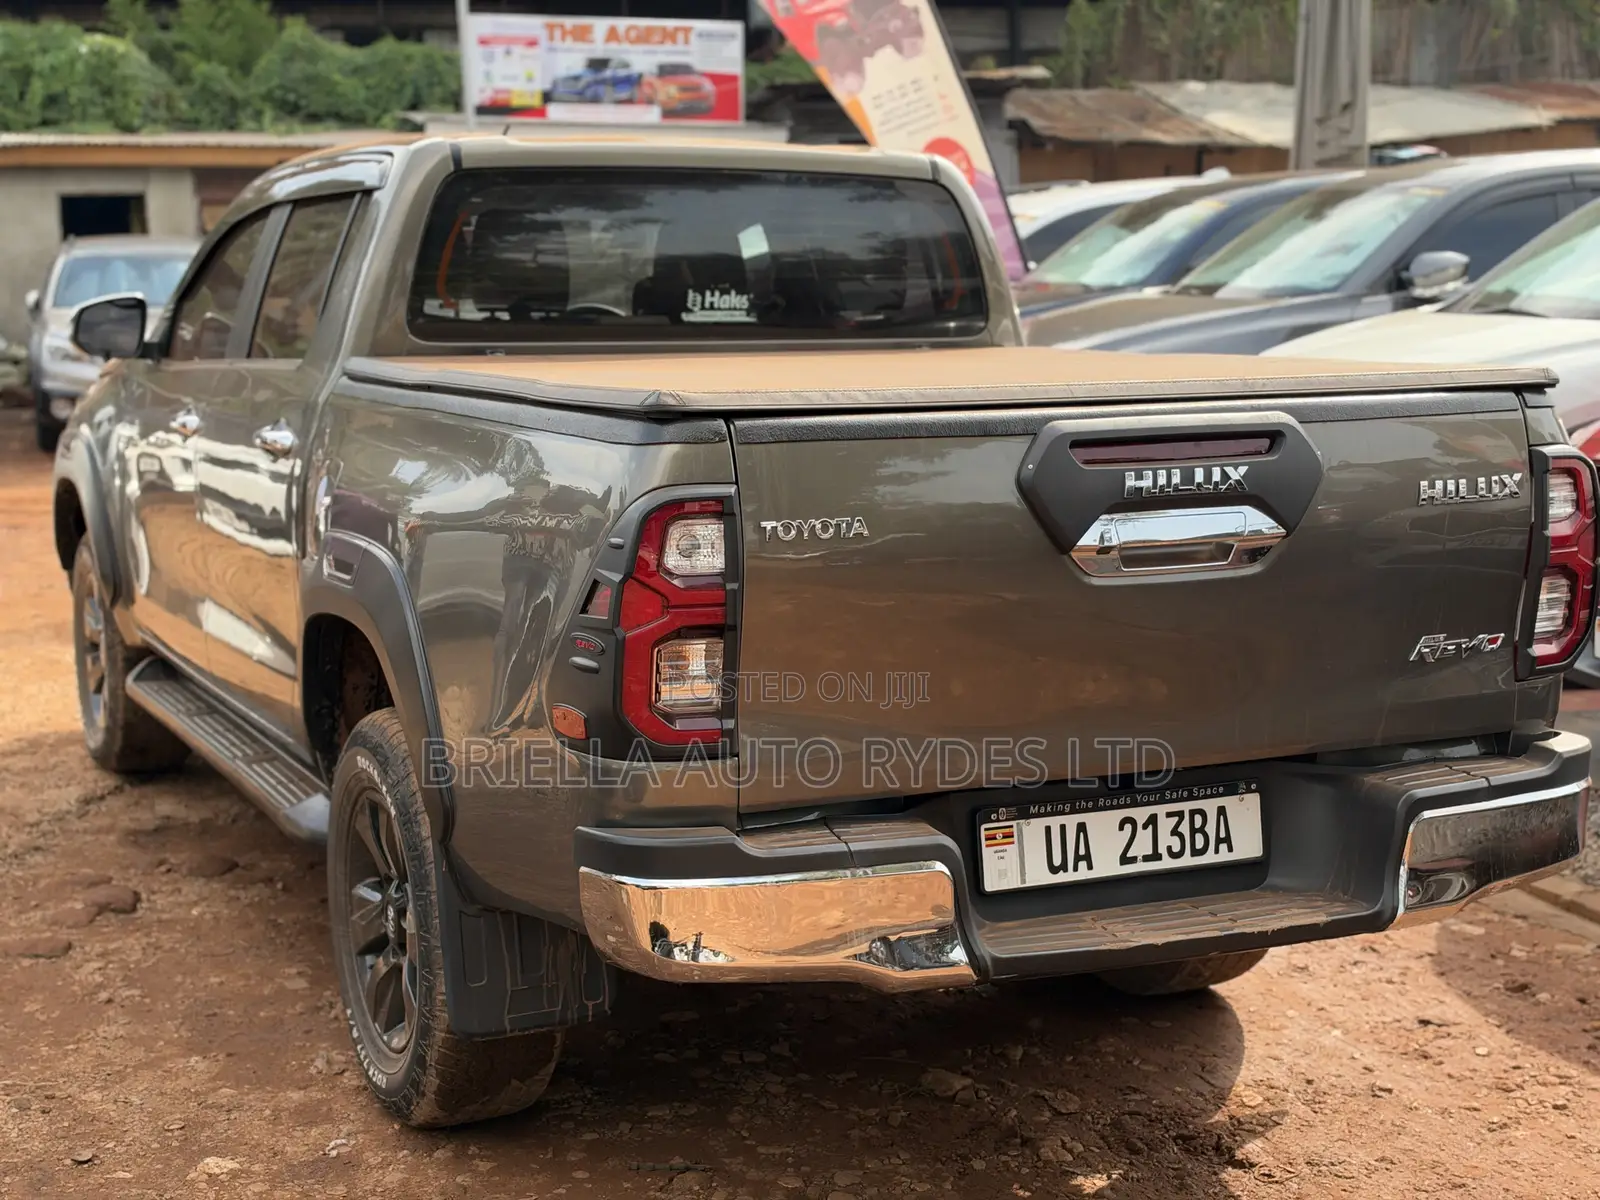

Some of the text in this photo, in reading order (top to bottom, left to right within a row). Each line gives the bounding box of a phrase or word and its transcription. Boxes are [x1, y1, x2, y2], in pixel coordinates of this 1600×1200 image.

[544, 21, 596, 44] THE
[604, 23, 694, 46] AGENT
[1124, 466, 1249, 499] HILUX
[1418, 473, 1523, 506] HILUX
[760, 516, 869, 542] TOYOTA
[1029, 804, 1071, 816] Making
[1075, 800, 1094, 809] the
[1098, 796, 1131, 807] Roads
[1136, 793, 1160, 803] Your
[1165, 789, 1188, 800] Safe
[1192, 786, 1224, 797] Space
[1044, 805, 1234, 875] UA 213BA
